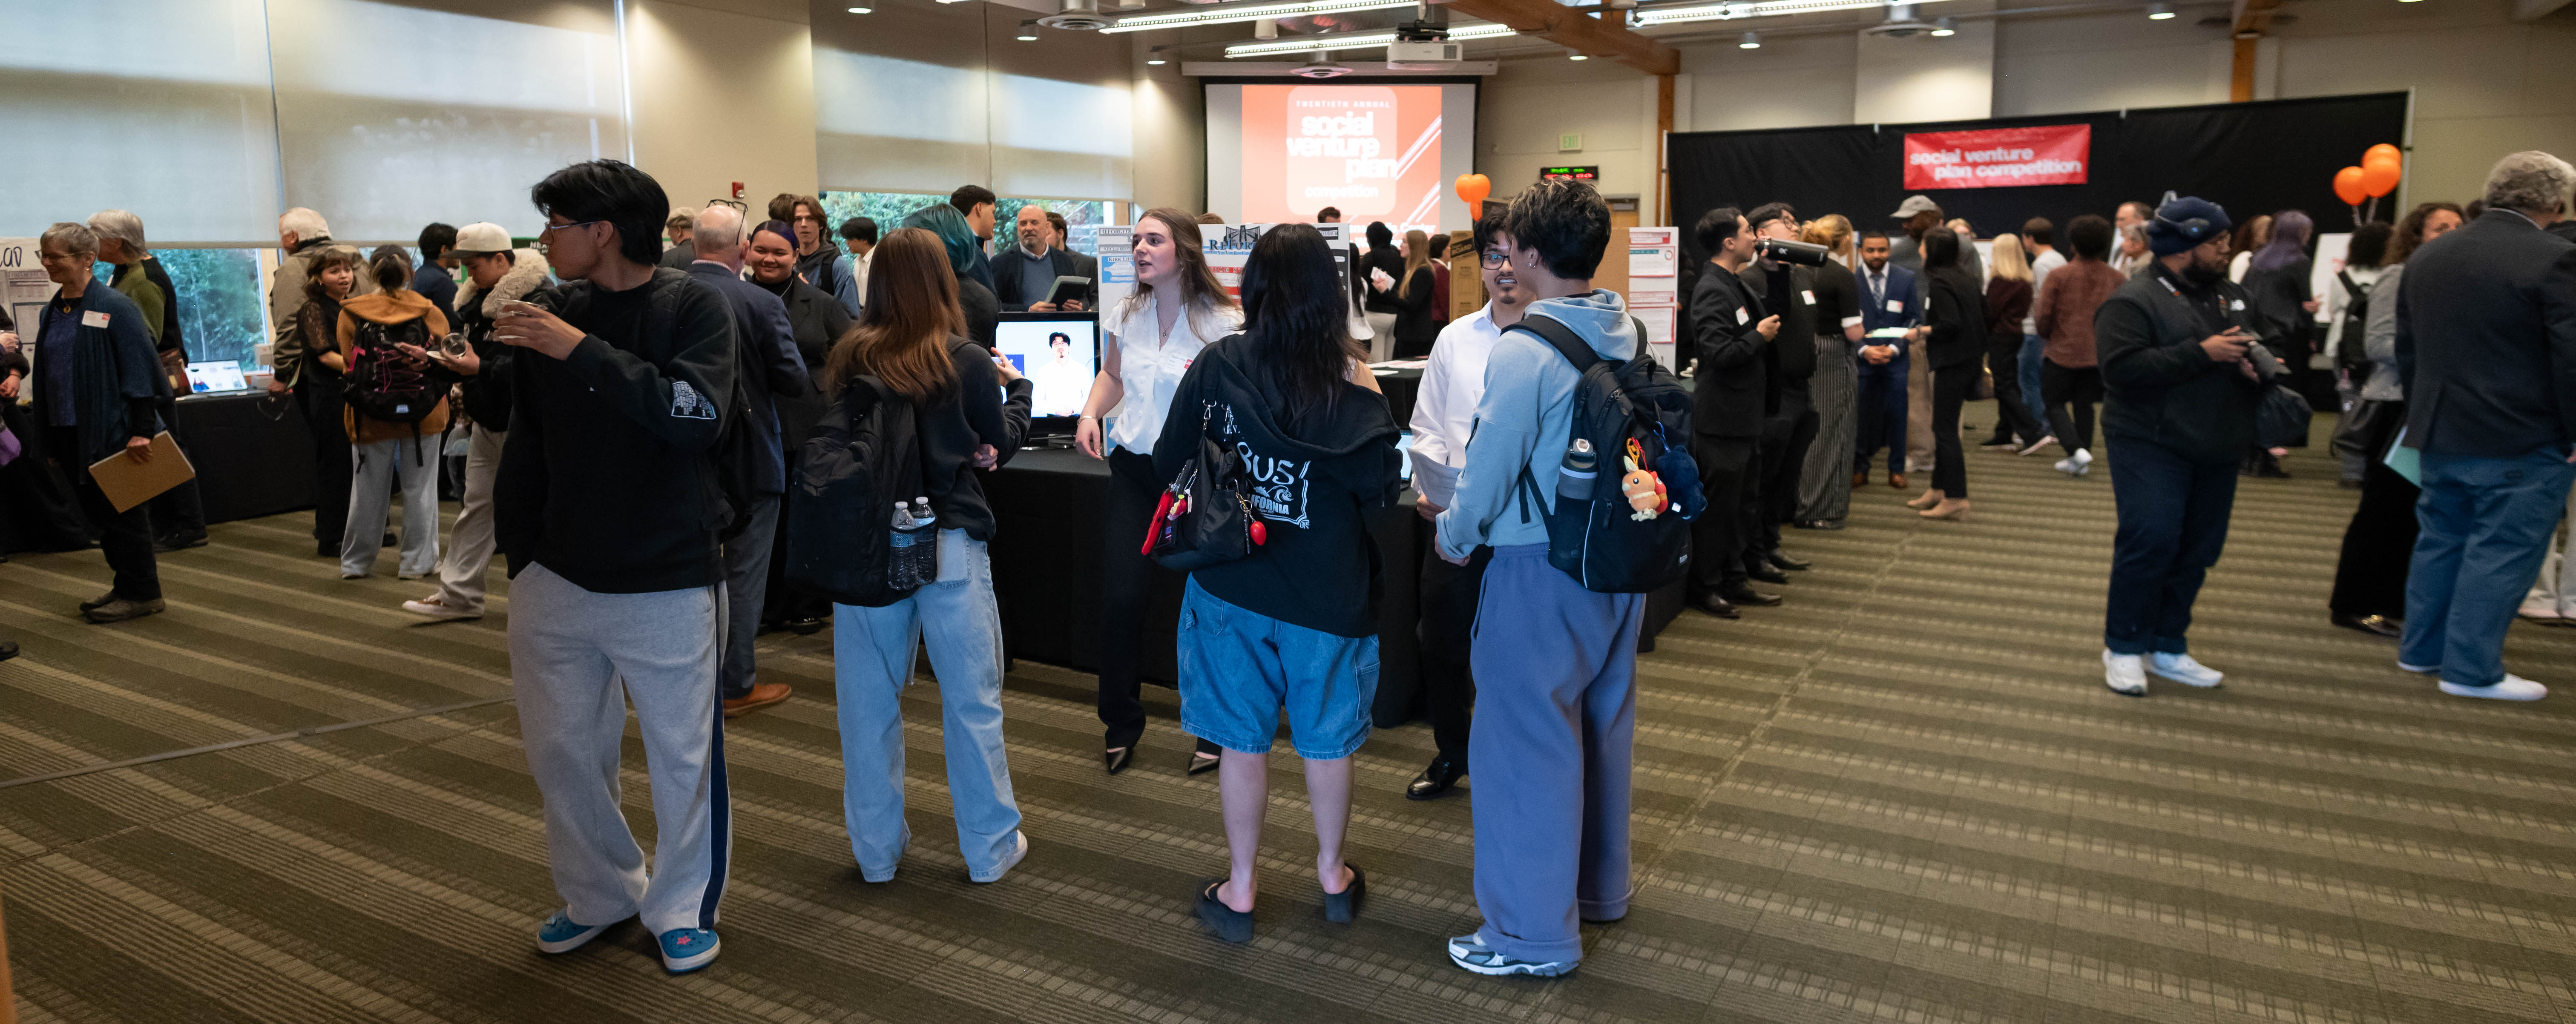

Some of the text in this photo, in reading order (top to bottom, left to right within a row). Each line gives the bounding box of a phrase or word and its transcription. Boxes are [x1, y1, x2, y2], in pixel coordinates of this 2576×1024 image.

[1301, 111, 1374, 136] social
[1286, 133, 1380, 157] venture
[1910, 147, 2034, 165] social venture
[1346, 154, 1397, 184] plan
[1934, 159, 2082, 181] plan competition
[1305, 184, 1379, 200] competition
[1250, 494, 1290, 515] IFORNIA
